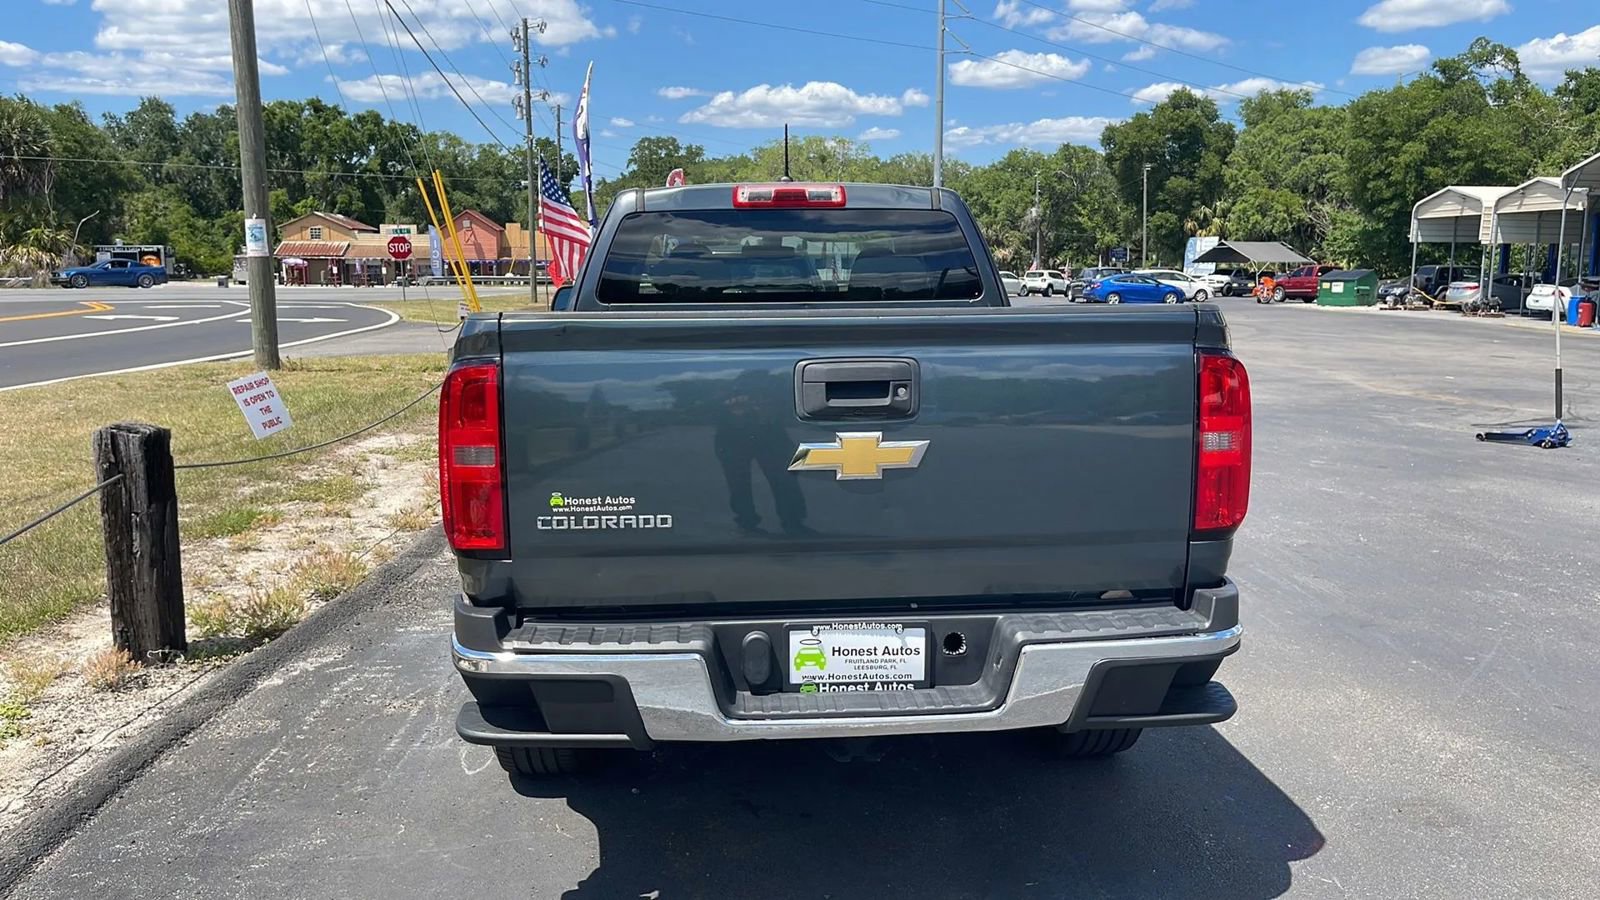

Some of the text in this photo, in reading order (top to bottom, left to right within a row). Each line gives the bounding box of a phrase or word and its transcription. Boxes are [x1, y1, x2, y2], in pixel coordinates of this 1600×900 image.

[389, 243, 410, 253] STOP
[232, 377, 270, 395] REPAIR SHOP
[242, 390, 275, 407] IS OPEN TO
[259, 405, 273, 416] THE
[261, 416, 283, 430] PUBLIC
[564, 496, 636, 506] Honest Autos
[536, 514, 673, 530] COLORADO
[813, 622, 903, 630] www.HonestAutos.com
[832, 645, 921, 657] Honest Autos
[802, 672, 912, 681] www.HonestAutos.com
[819, 682, 915, 693] Honest Autos
